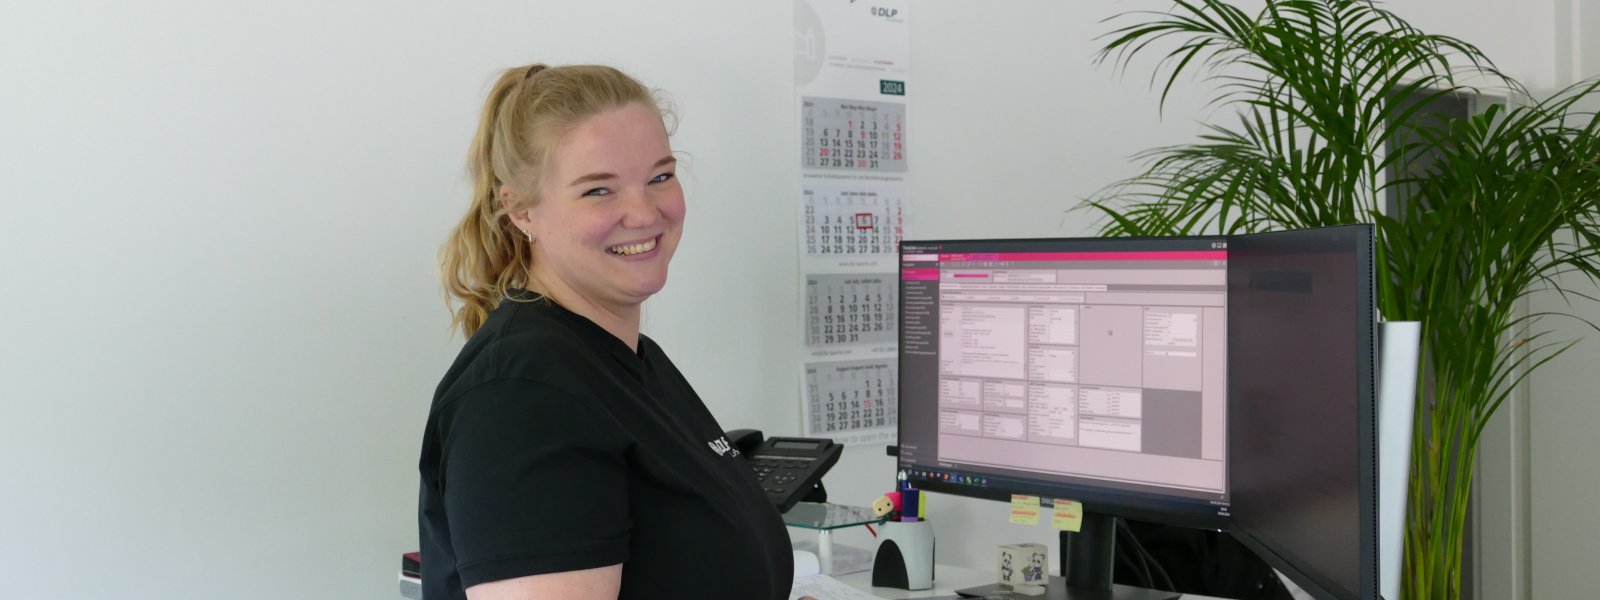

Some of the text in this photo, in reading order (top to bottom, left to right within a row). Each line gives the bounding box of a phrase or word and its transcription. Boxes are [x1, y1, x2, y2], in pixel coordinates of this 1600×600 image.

[878, 8, 898, 17] DLP
[882, 82, 902, 94] 2024
[860, 121, 865, 129] 2
[873, 121, 877, 130] 3
[896, 123, 901, 131] 5
[823, 128, 828, 137] 6
[836, 129, 840, 137] 7
[848, 130, 853, 138] 8
[860, 131, 865, 139] 9
[869, 131, 878, 140] 10
[893, 132, 901, 141] 12
[806, 138, 815, 146] 20
[820, 138, 828, 146] 13
[832, 139, 841, 147] 14
[845, 139, 853, 148] 15
[857, 140, 866, 148] 16
[870, 140, 878, 149] 17
[894, 142, 902, 150] 19
[806, 147, 814, 156] 21
[820, 148, 829, 156] 20
[832, 149, 841, 157] 21
[844, 149, 853, 158] 22
[856, 150, 866, 158] 23
[869, 150, 878, 159] 24
[893, 152, 902, 160] 26
[820, 158, 829, 166] 27
[832, 158, 841, 167] 28
[845, 159, 854, 167] 29
[857, 160, 867, 168] 30
[870, 160, 878, 168] 31
[897, 207, 902, 215] 2
[825, 216, 829, 224] 3
[837, 216, 842, 224] 4
[850, 216, 854, 224] 5
[874, 216, 879, 224] 7
[898, 216, 902, 224] 9
[821, 226, 830, 234] 10
[834, 226, 842, 234] 11
[846, 226, 854, 234] 12
[894, 226, 903, 234] 16
[821, 236, 830, 244] 17
[858, 236, 867, 244] 20
[871, 236, 879, 244] 21
[821, 245, 830, 254] 24
[834, 245, 843, 254] 25
[846, 245, 855, 254] 26
[859, 245, 868, 254] 27
[871, 245, 880, 254] 28
[840, 295, 844, 303] 2
[852, 294, 857, 303] 3
[865, 294, 870, 302] 4
[877, 294, 881, 302] 5
[840, 305, 845, 313] 9
[849, 304, 857, 313] 10
[874, 304, 881, 312] 12
[824, 315, 833, 324] 15
[837, 315, 845, 323] 16
[849, 314, 858, 322] 17
[862, 314, 870, 322] 18
[824, 325, 833, 333] 22
[836, 325, 845, 333] 23
[849, 324, 858, 332] 24
[861, 324, 871, 332] 25
[874, 323, 882, 331] 26
[825, 335, 834, 343] 29
[837, 335, 846, 343] 30
[877, 379, 882, 387] 2
[829, 393, 834, 401] 5
[841, 392, 846, 400] 6
[854, 391, 858, 399] 7
[878, 389, 882, 397] 9
[826, 403, 834, 411] 12
[838, 402, 847, 410] 13
[851, 401, 860, 409] 14
[875, 399, 884, 407] 16
[826, 413, 835, 421] 19
[838, 412, 847, 420] 20
[851, 411, 860, 419] 21
[863, 410, 872, 418] 22
[875, 408, 884, 416] 23
[827, 423, 835, 431] 26
[839, 422, 848, 430] 27
[851, 421, 861, 429] 28
[863, 419, 873, 428] 29
[875, 418, 885, 426] 30
